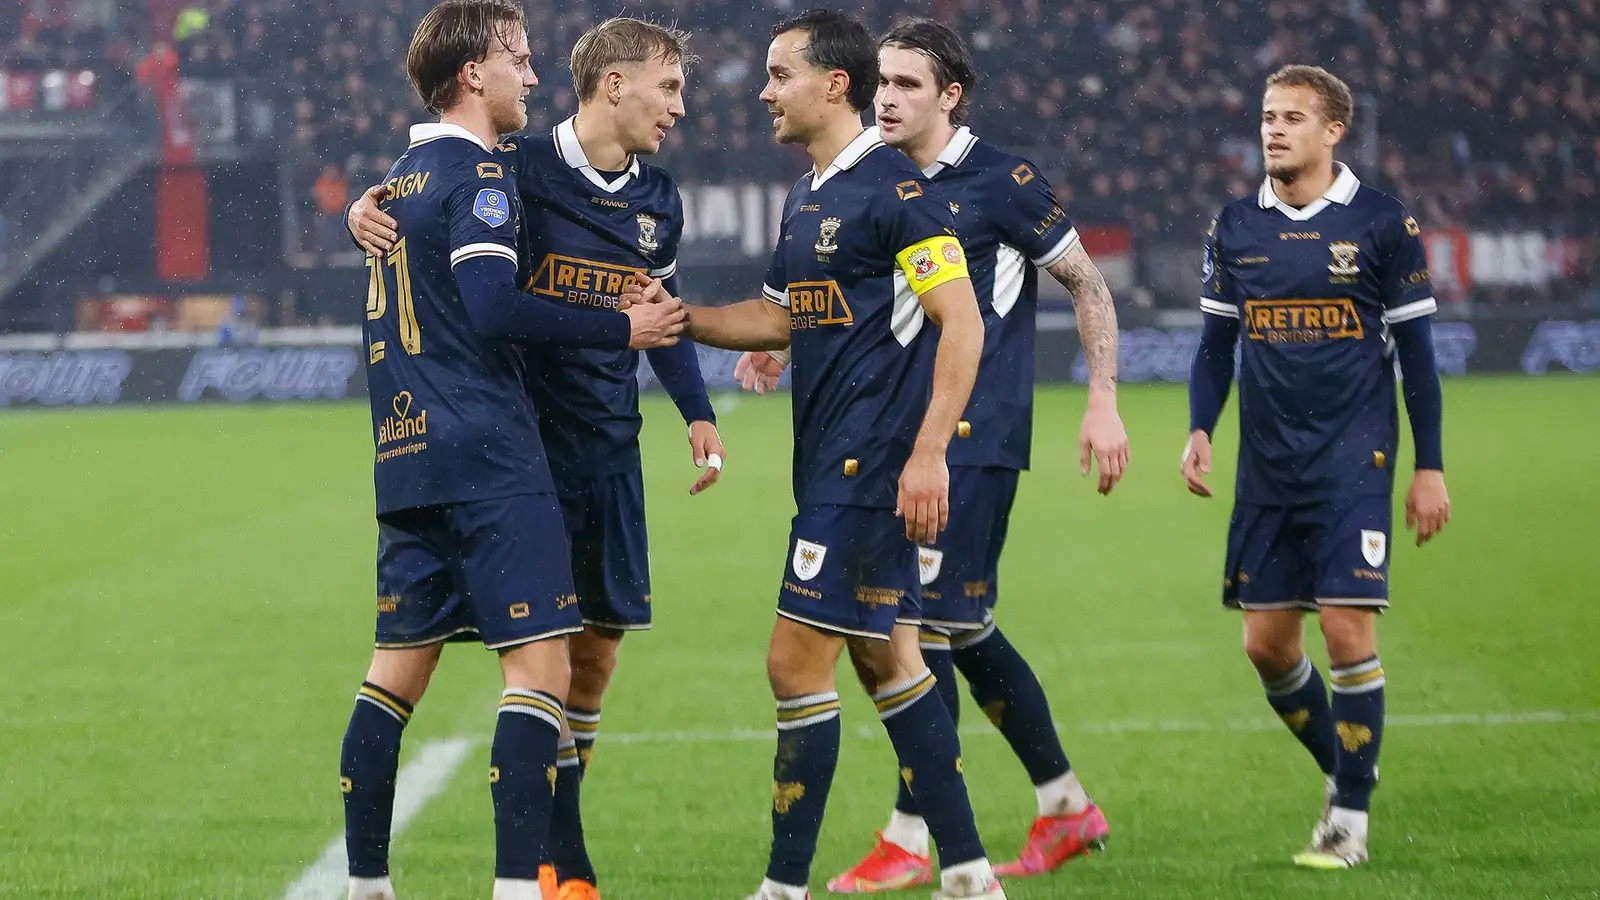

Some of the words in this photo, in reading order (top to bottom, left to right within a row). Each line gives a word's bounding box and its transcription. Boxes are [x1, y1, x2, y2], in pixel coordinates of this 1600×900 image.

[380, 171, 430, 204] SIGN
[567, 290, 621, 310] BRIDGE
[1255, 306, 1341, 329] RETRO
[1267, 328, 1323, 344] BRIDGE
[0, 350, 132, 405] OUR
[178, 349, 359, 402] FOUR
